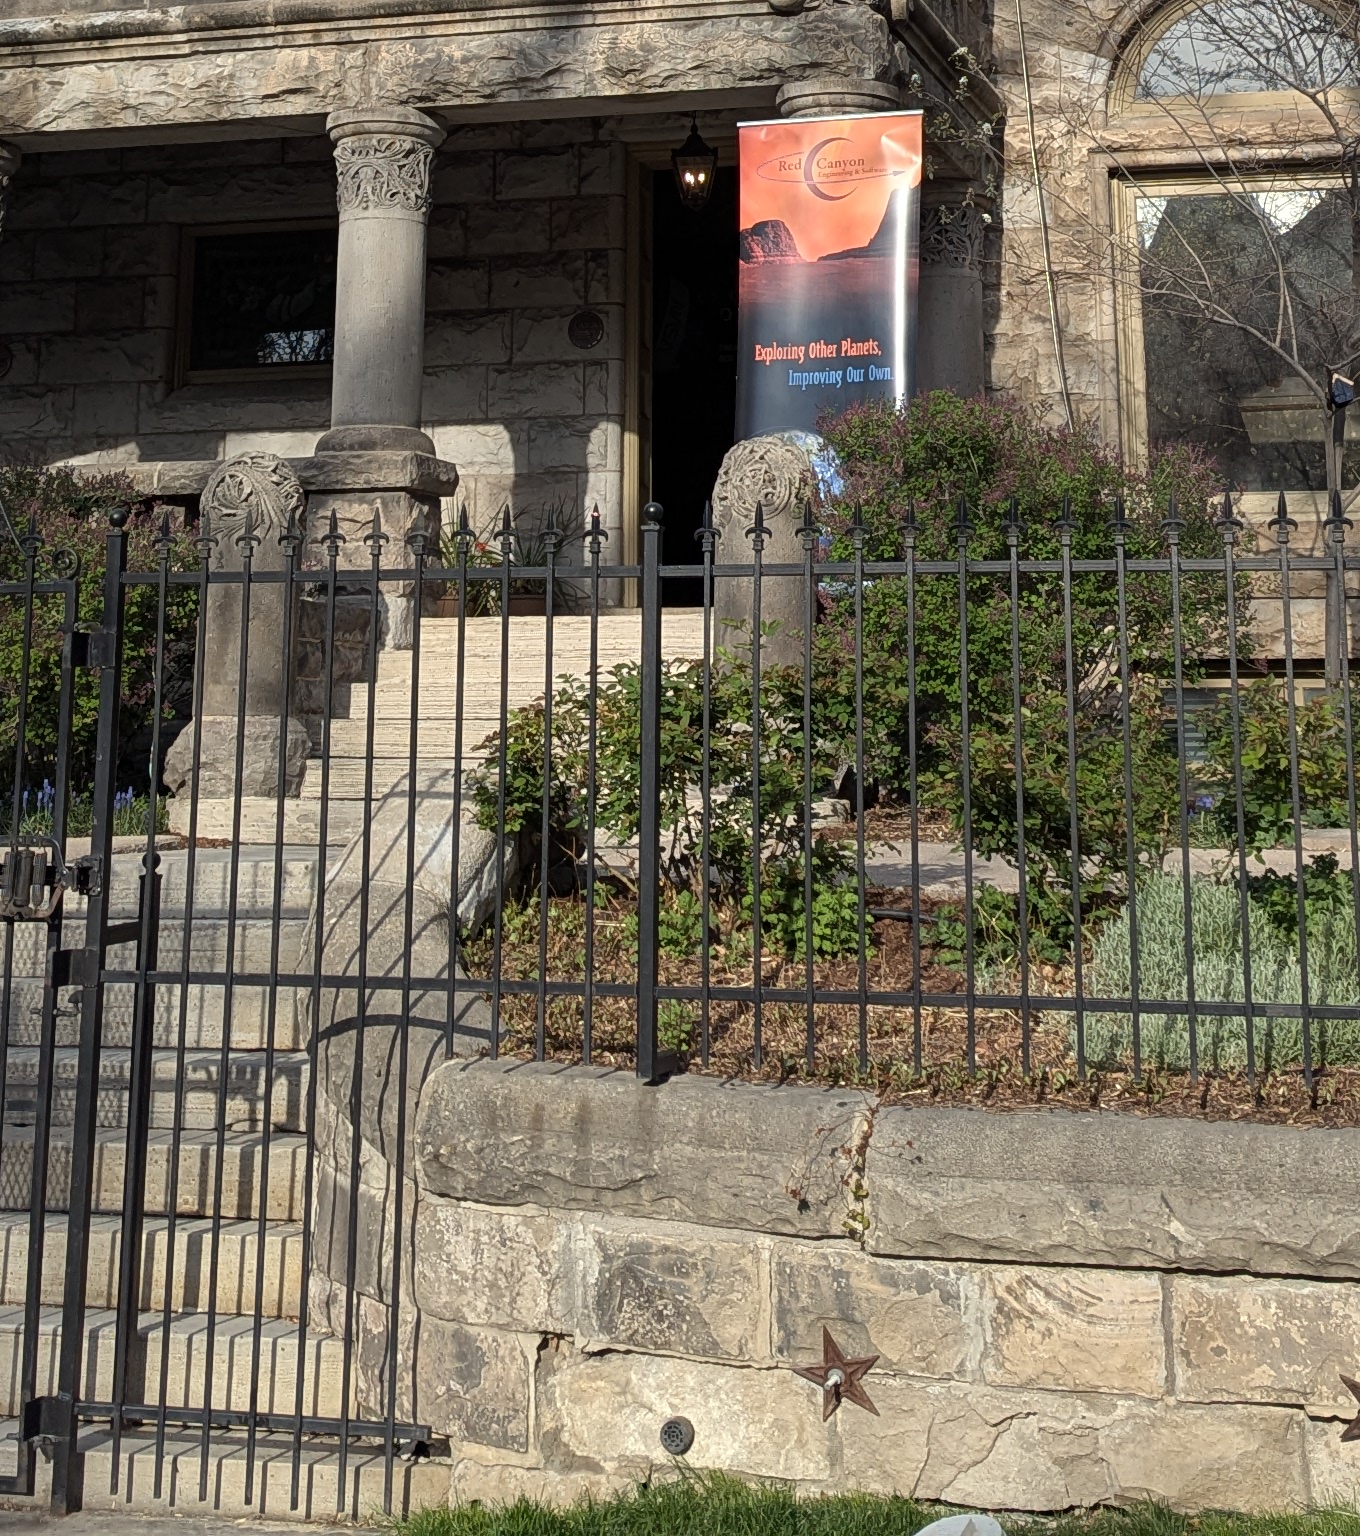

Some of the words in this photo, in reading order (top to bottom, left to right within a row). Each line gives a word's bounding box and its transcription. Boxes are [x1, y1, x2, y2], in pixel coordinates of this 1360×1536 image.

[778, 158, 802, 172] Red
[816, 157, 865, 172] Canyon
[818, 169, 853, 179] Engineering
[754, 341, 806, 365] Exploring
[808, 339, 838, 359] Other
[840, 337, 882, 357] Planets,
[788, 367, 843, 391] Improving
[846, 366, 865, 383] Our
[868, 364, 895, 382] Own.
